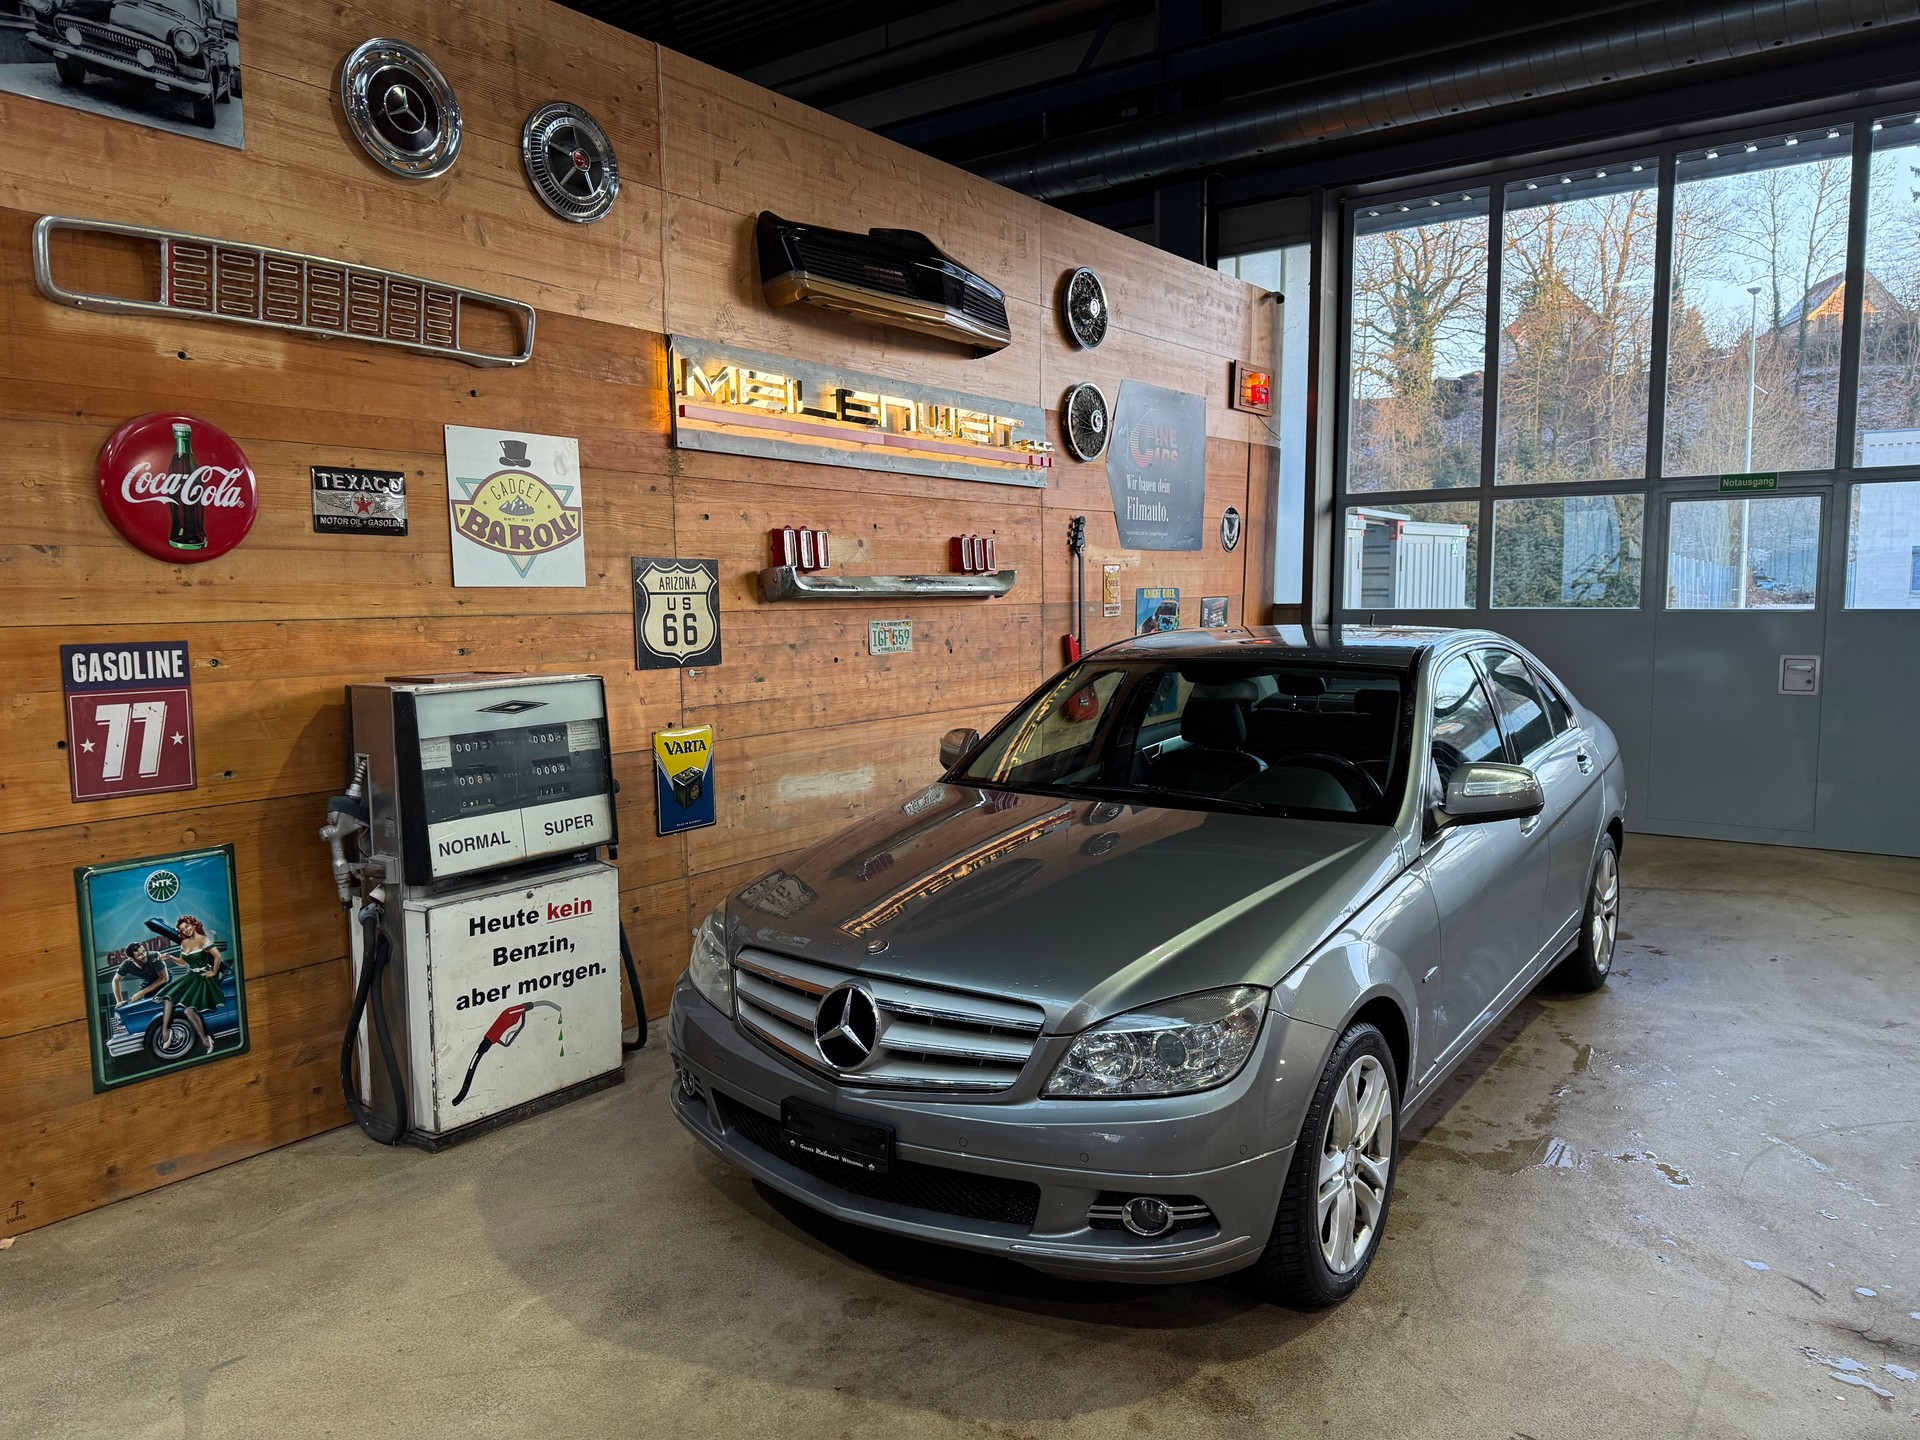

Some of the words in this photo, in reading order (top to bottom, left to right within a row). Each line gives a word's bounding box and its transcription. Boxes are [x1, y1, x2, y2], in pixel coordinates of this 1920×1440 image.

[121, 461, 244, 508] Coca-Cola
[316, 471, 404, 494] TEXACO
[490, 478, 545, 503] GADGET
[1126, 474, 1138, 491] Wir
[1157, 478, 1171, 494] dein
[1722, 478, 1774, 488] Notausgang
[320, 516, 349, 526] MOTOR
[349, 517, 363, 527] OIL
[367, 518, 405, 528] GASOLINE
[1126, 496, 1169, 522] Filmauto.
[460, 507, 578, 550] BARON
[659, 576, 697, 591] ARIZONA
[663, 613, 698, 647] 66
[71, 649, 185, 683] GASOLINE
[95, 701, 168, 782] 77
[664, 739, 707, 756] VARTA
[438, 830, 511, 858] NORMAL
[544, 814, 594, 837] SUPER
[152, 878, 174, 889] NTK
[469, 907, 540, 937] Heute
[547, 897, 593, 921] kein
[492, 936, 576, 967] Benzin,
[455, 985, 511, 1011] aber
[518, 961, 607, 996] morgen.
